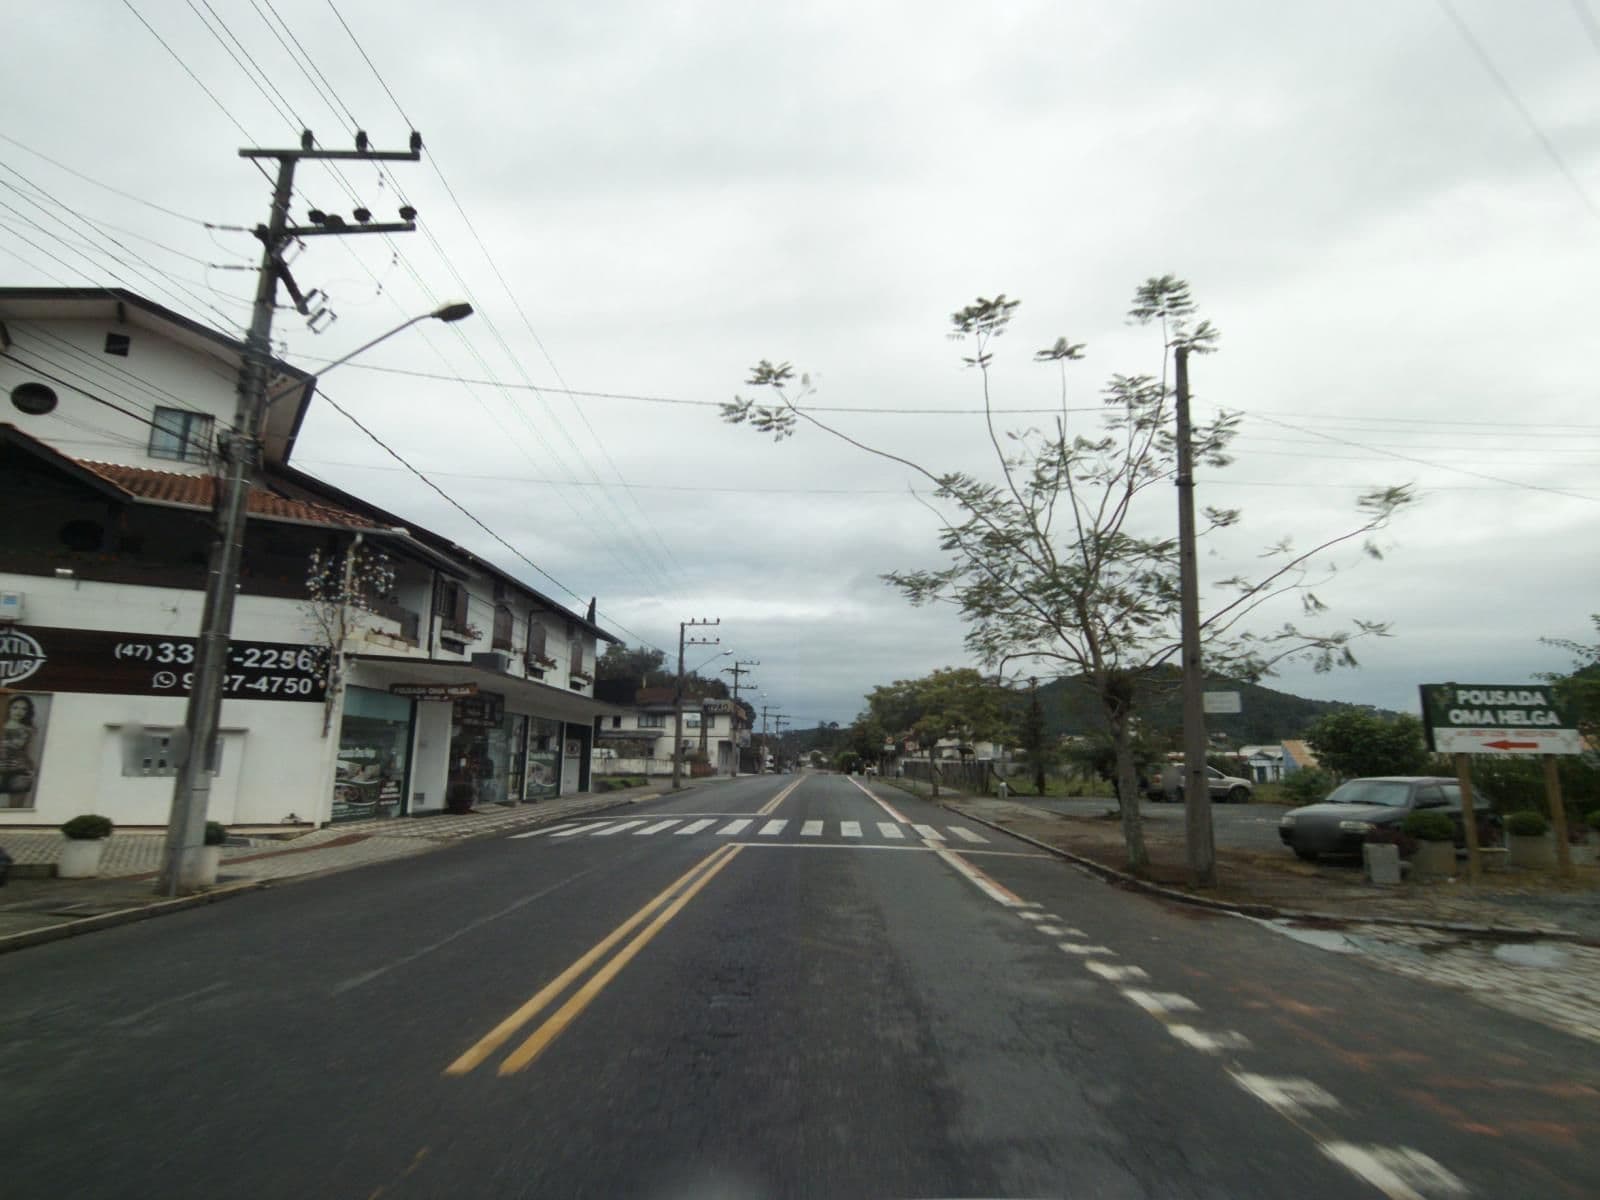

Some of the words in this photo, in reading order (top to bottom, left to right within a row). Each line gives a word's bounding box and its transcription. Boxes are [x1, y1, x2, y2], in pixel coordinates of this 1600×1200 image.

[114, 643, 153, 661] (47)
[156, 642, 313, 670] 33-2256
[1455, 689, 1547, 706] POUSADA
[1449, 708, 1496, 725] OMA
[1497, 709, 1561, 726] HELGA
